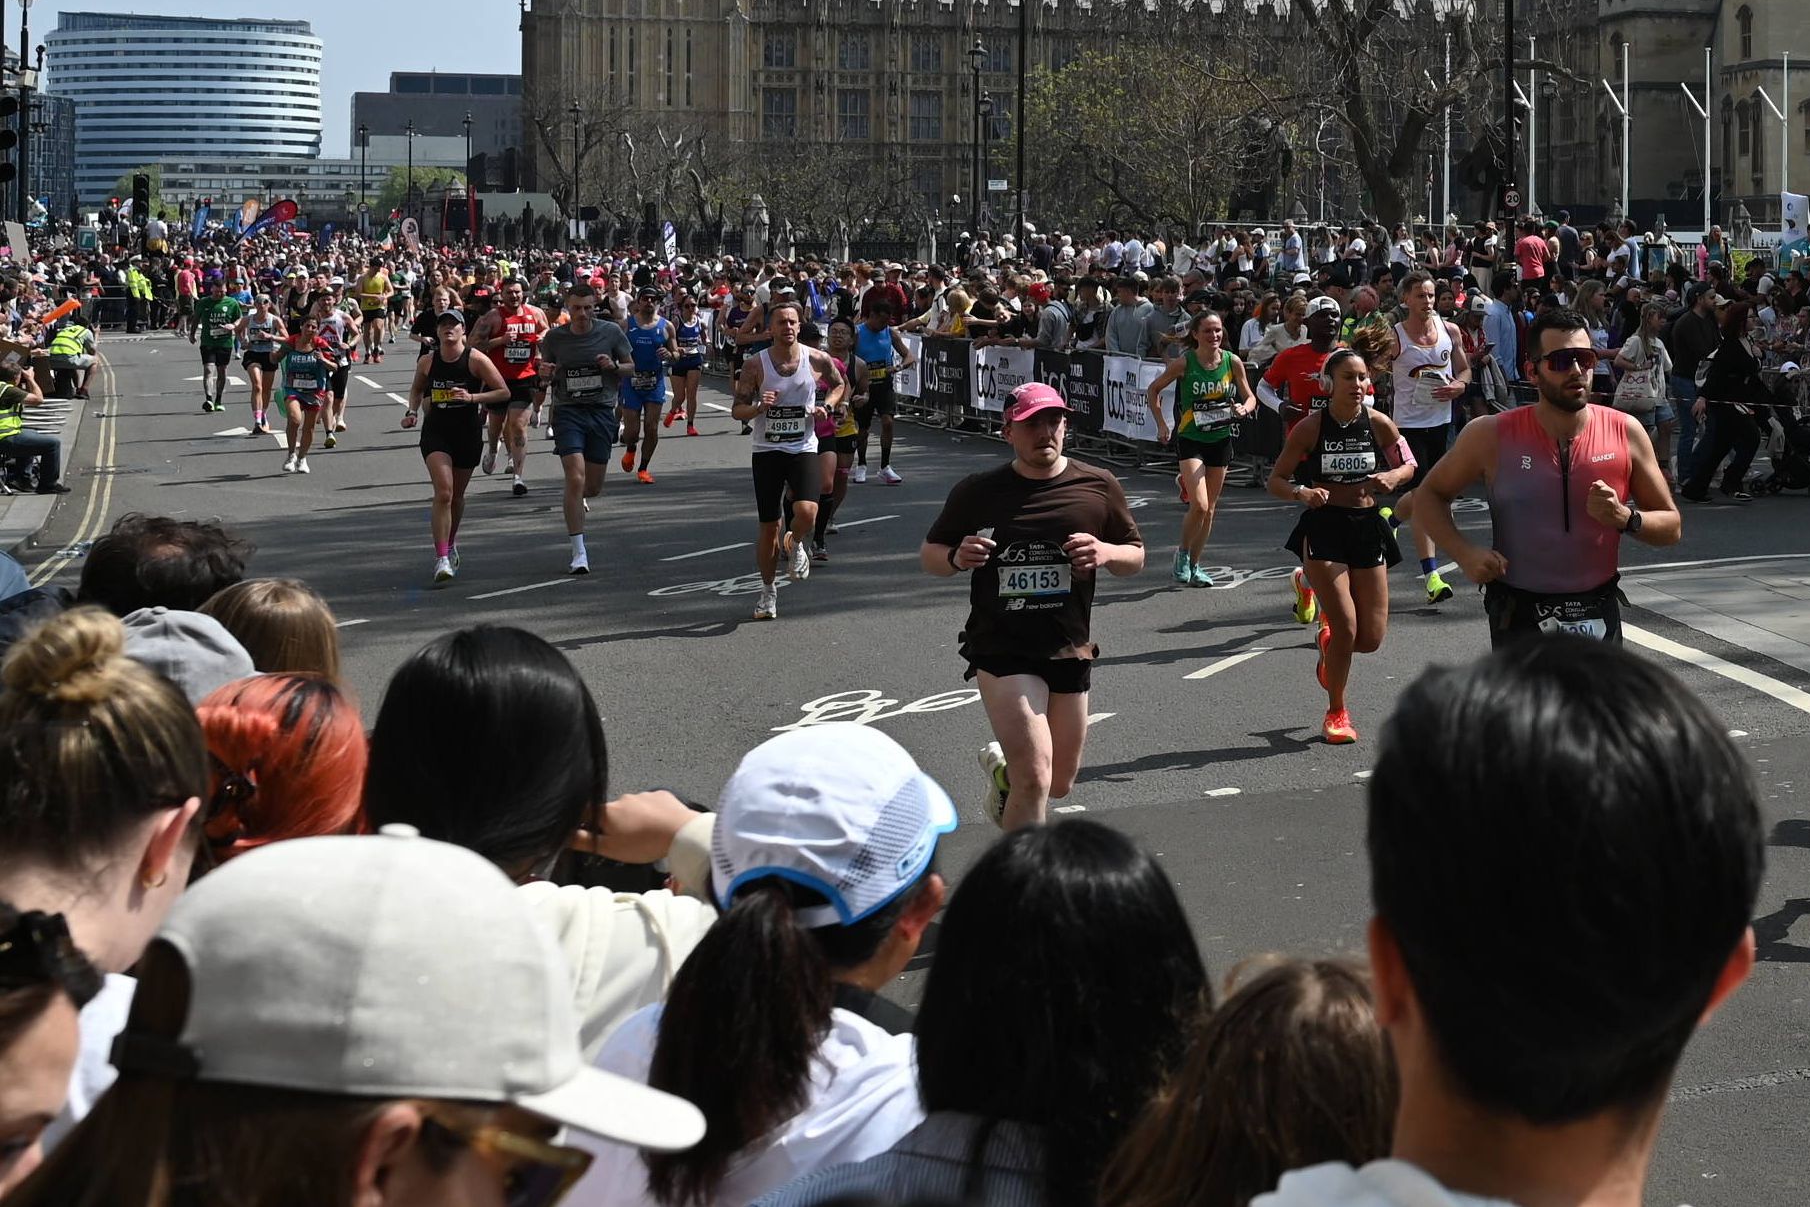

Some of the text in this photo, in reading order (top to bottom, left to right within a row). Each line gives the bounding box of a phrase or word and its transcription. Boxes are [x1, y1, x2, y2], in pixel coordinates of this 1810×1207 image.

[1506, 194, 1519, 203] 20
[507, 323, 535, 333] DYLAN
[976, 354, 996, 399] tcs
[1192, 380, 1230, 395] SARAH
[1106, 370, 1124, 421] tcs
[1312, 397, 1327, 408] tcs
[771, 421, 799, 431] 49878
[1324, 439, 1344, 451] tcs
[1591, 452, 1615, 463] BANDIT
[1330, 457, 1368, 471] 46805
[1007, 571, 1060, 590] 46153
[1040, 601, 1064, 609] balance
